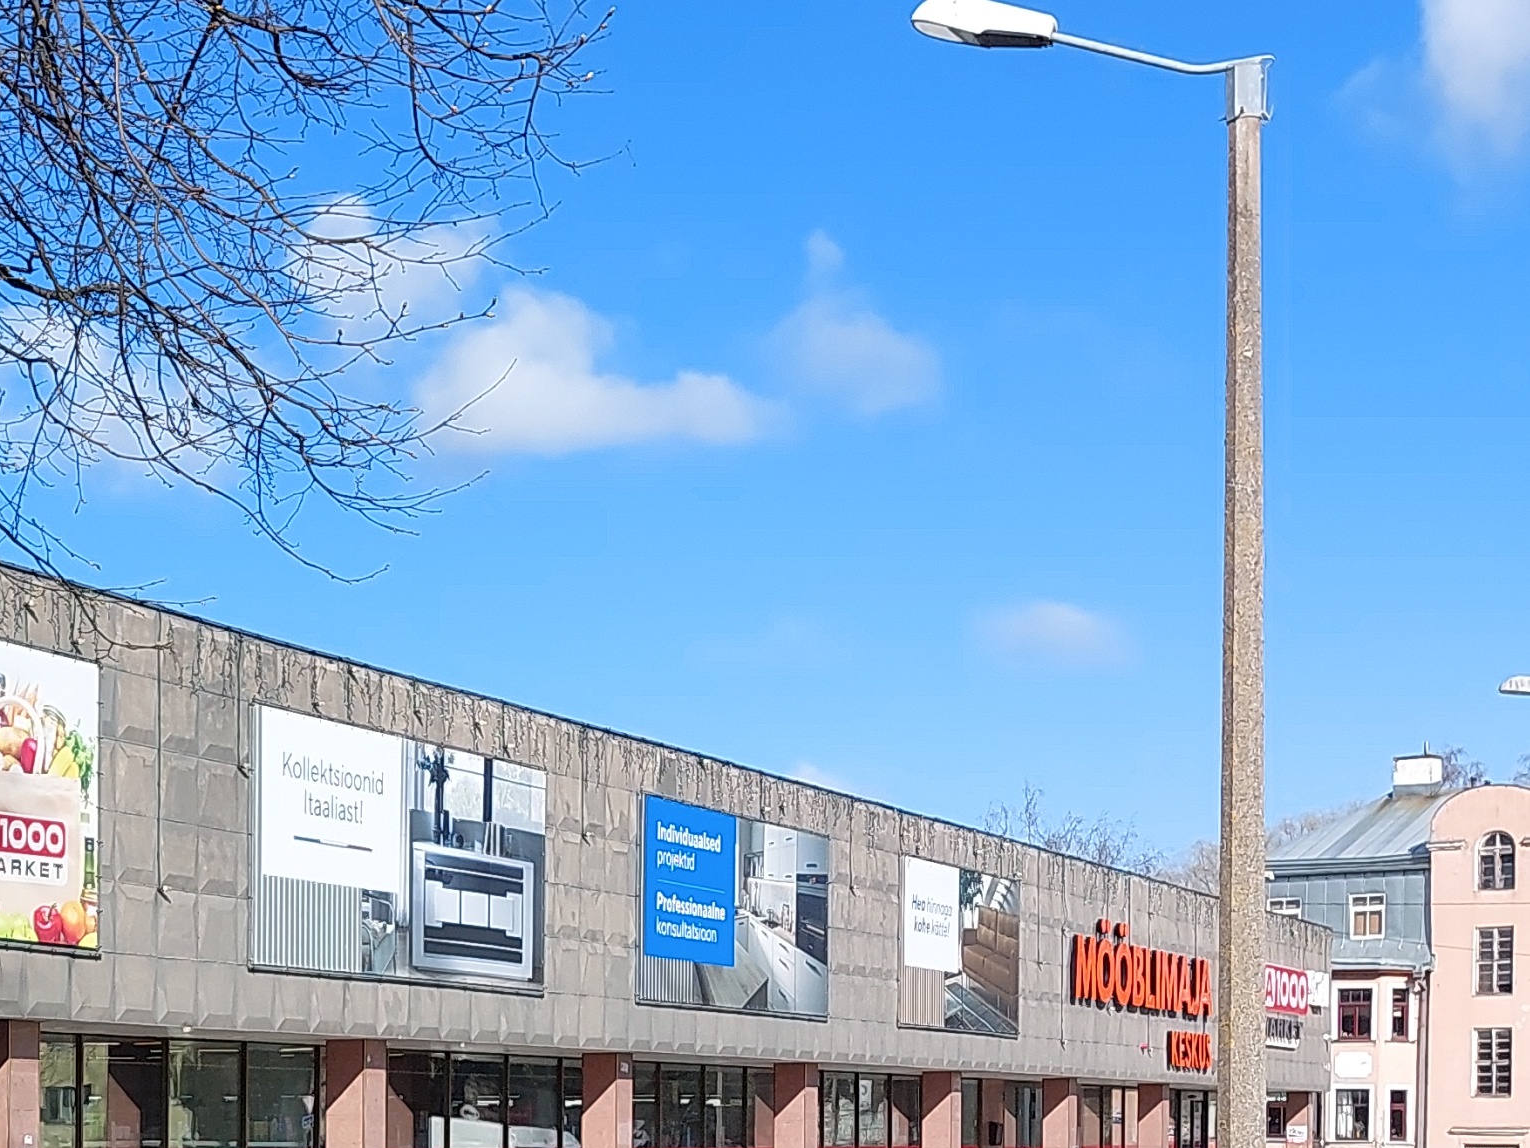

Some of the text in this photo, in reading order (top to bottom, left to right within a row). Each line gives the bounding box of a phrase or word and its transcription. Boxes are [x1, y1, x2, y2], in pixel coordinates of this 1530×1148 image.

[282, 751, 384, 796] Kollektsioonid
[304, 788, 364, 825] Itaaliast!
[656, 820, 722, 853] Individuaalsed
[656, 848, 696, 872] projektid
[655, 891, 727, 922] Professionaalne
[655, 915, 718, 943] konsultatsioon
[1073, 918, 1213, 1016] MÖÖBLIMAJA
[1264, 967, 1307, 1010] A1000
[1170, 1031, 1213, 1069] KESKUS
